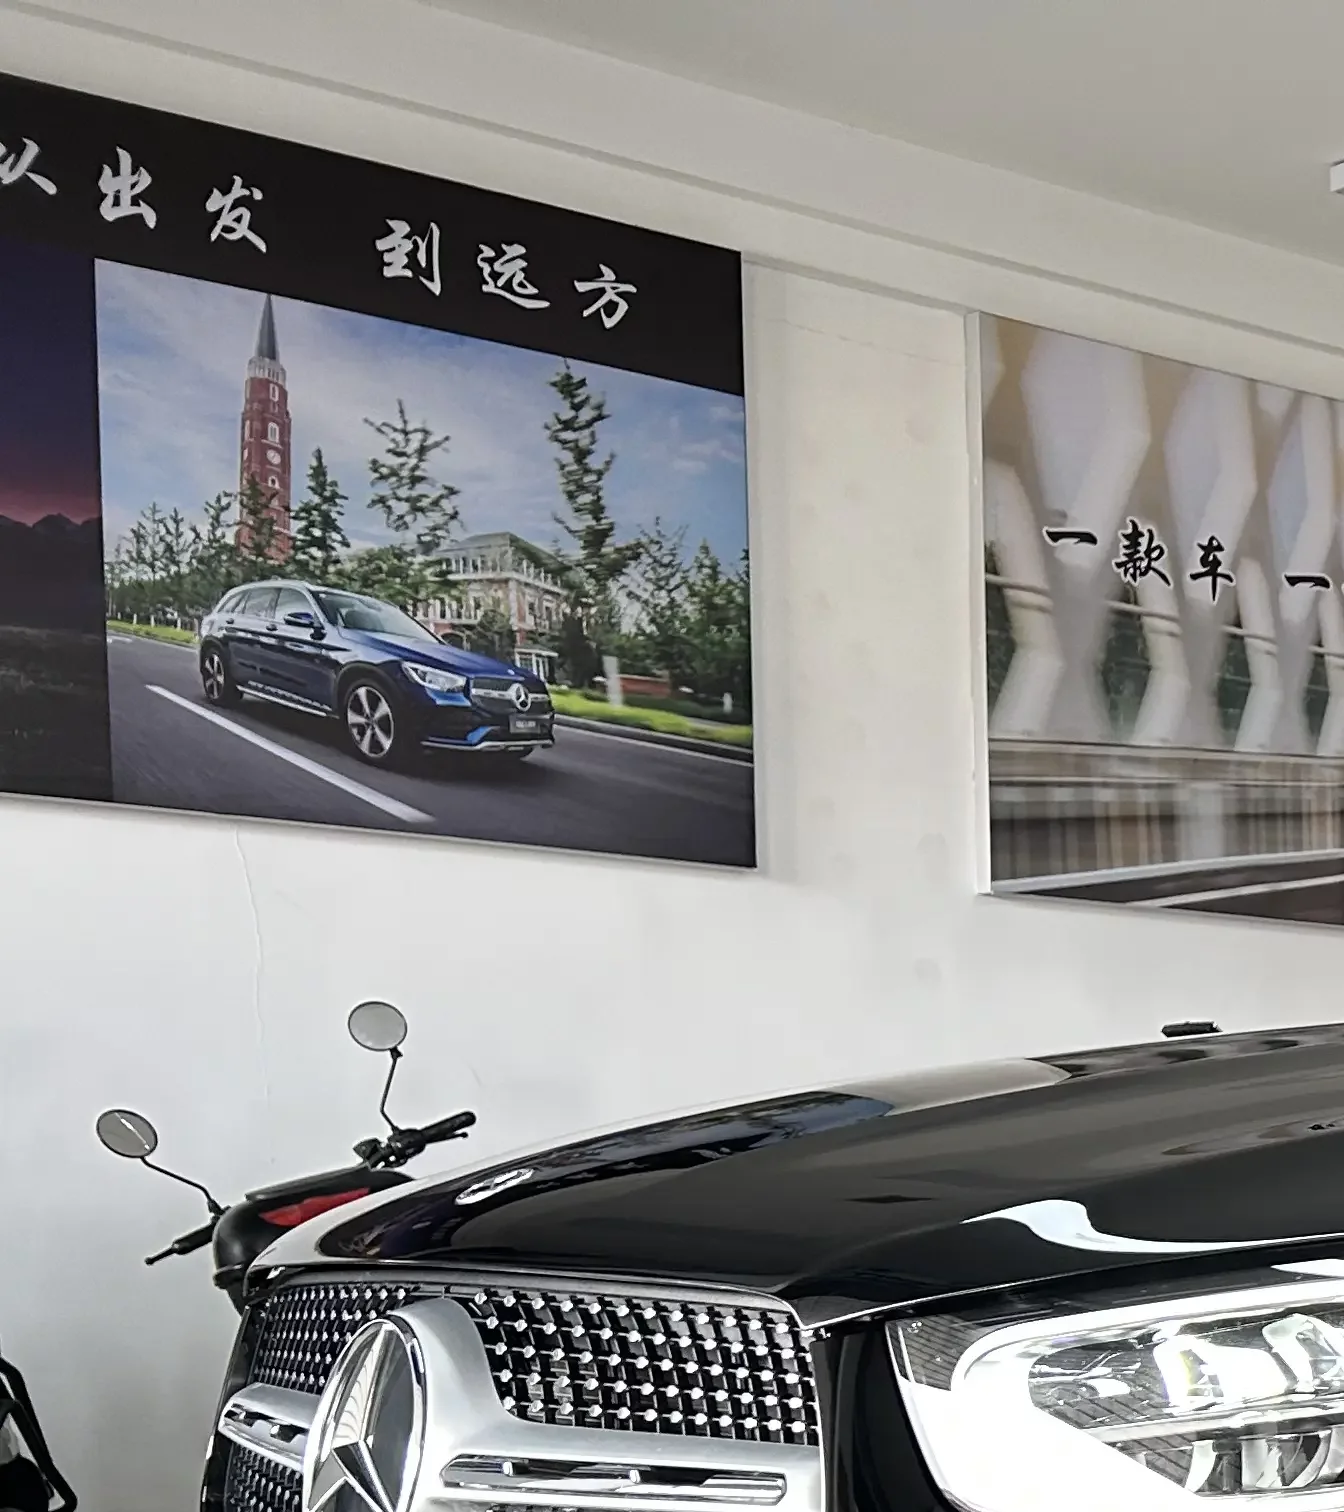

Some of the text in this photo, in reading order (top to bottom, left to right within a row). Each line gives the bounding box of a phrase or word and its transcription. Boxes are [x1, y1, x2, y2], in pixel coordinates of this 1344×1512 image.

[375, 218, 638, 330] 到远方
[1045, 518, 1235, 603] 一款车
